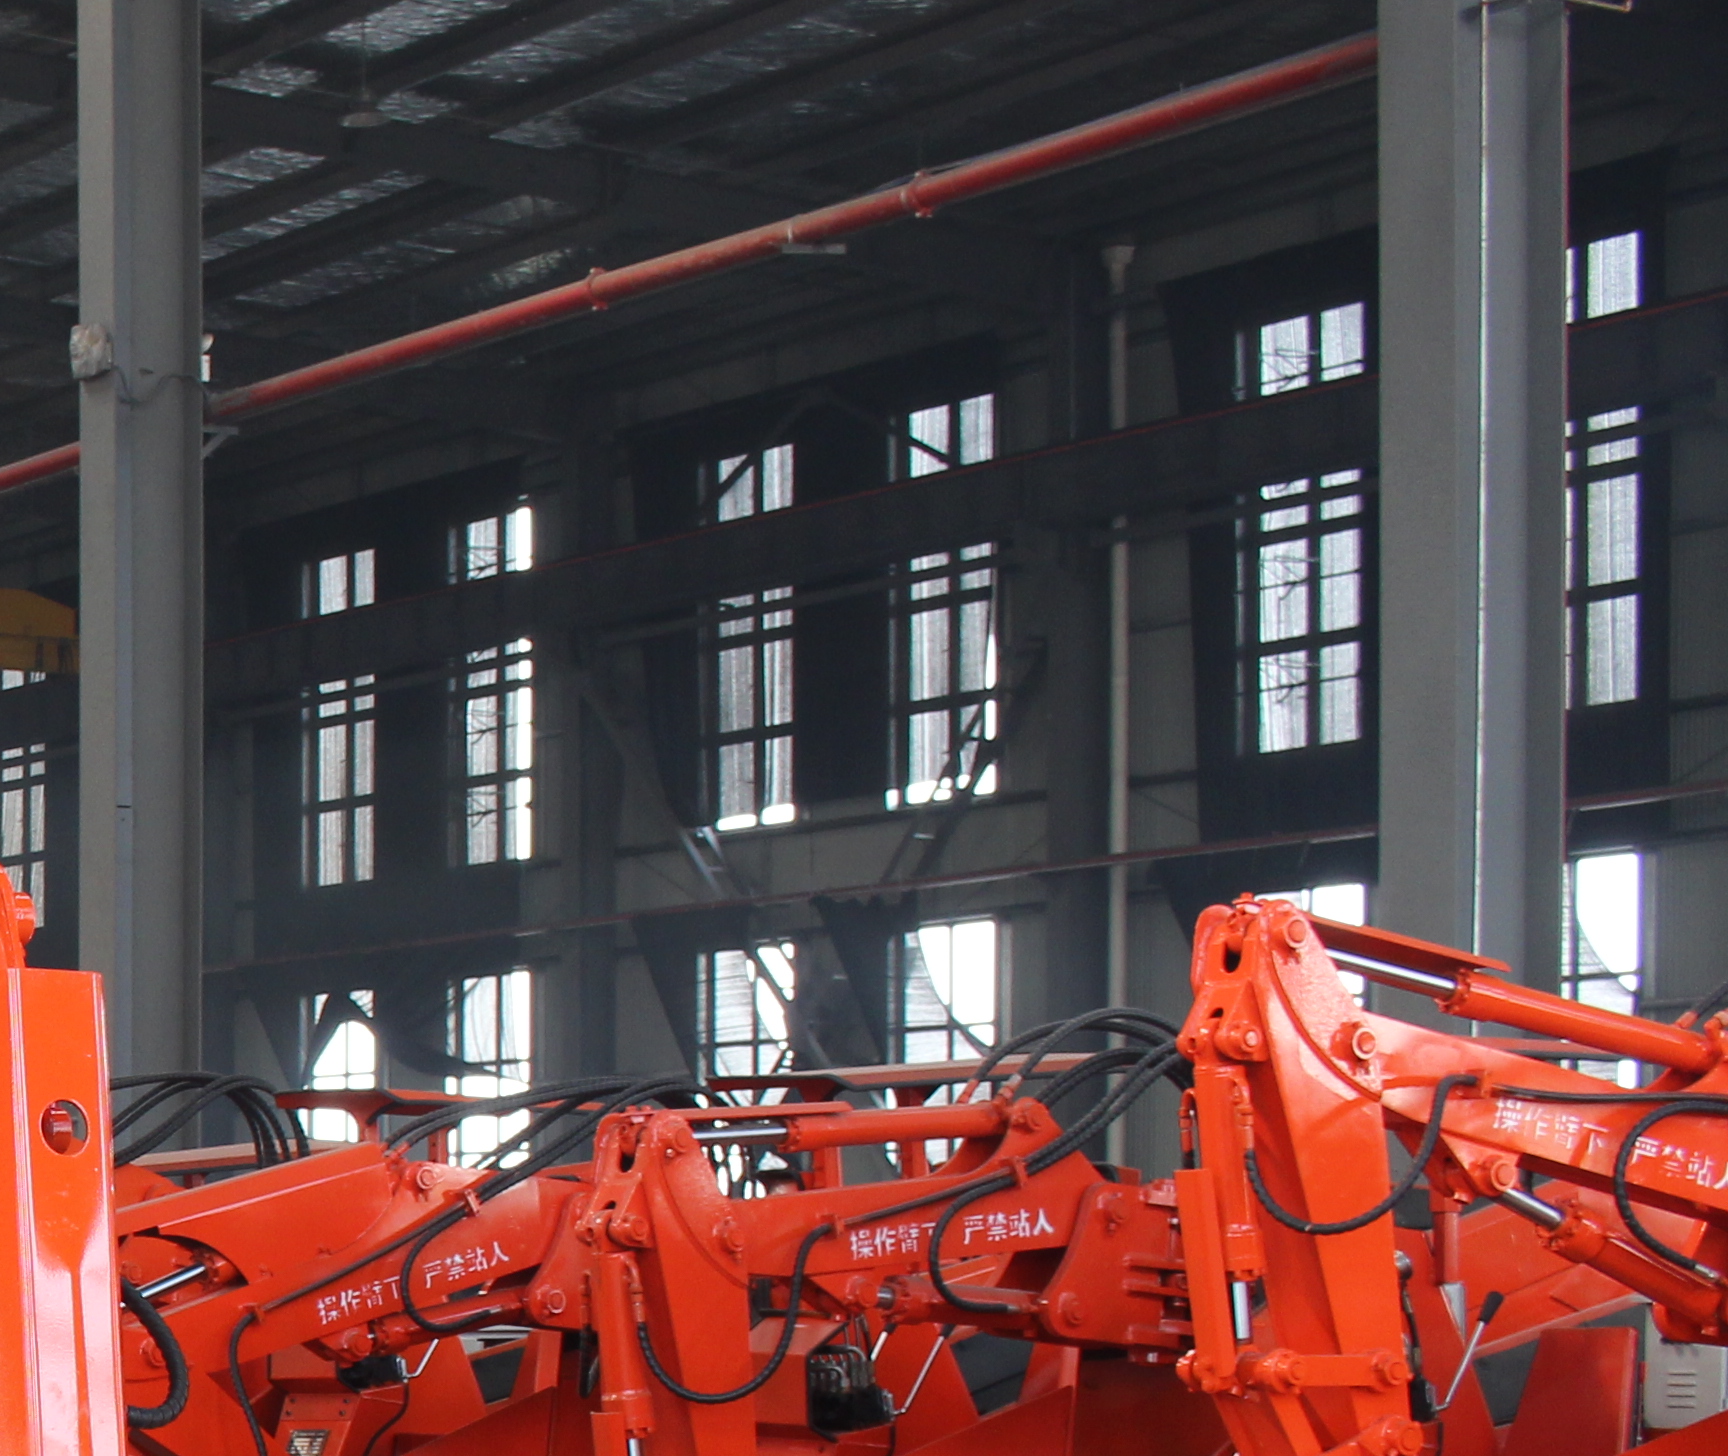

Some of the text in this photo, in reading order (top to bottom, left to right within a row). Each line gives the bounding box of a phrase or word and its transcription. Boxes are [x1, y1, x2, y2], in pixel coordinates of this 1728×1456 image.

[1493, 1098, 1610, 1156] 操作臂下
[962, 1207, 1056, 1246] 严禁站人
[422, 1240, 511, 1290] 严禁站人
